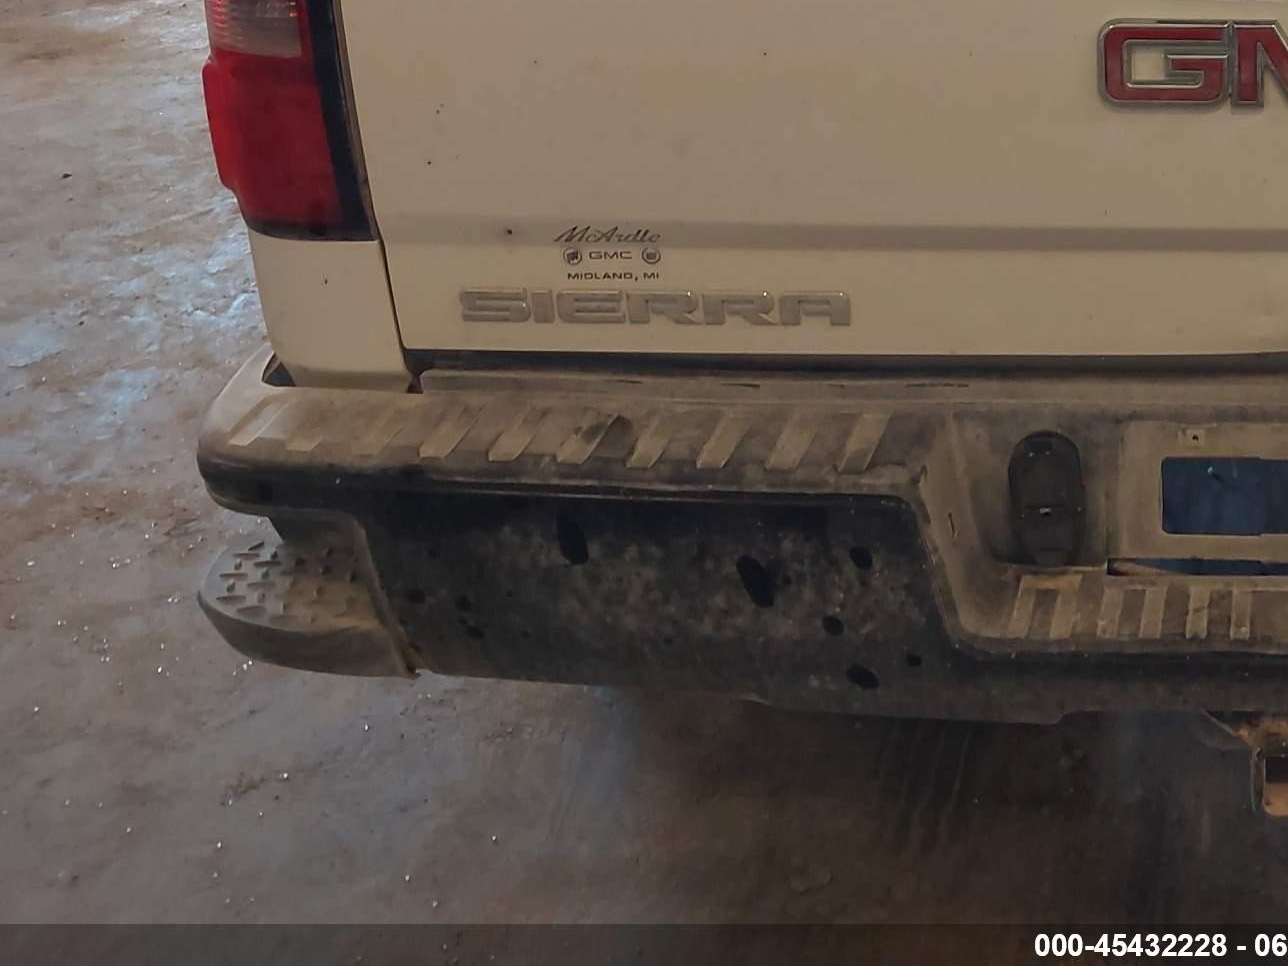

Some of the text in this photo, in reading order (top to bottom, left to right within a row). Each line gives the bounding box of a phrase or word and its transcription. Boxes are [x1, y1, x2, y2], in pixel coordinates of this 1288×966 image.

[589, 251, 633, 260] GMC
[567, 272, 660, 282] MIDLAND, MI
[460, 287, 851, 326] SIERRA
